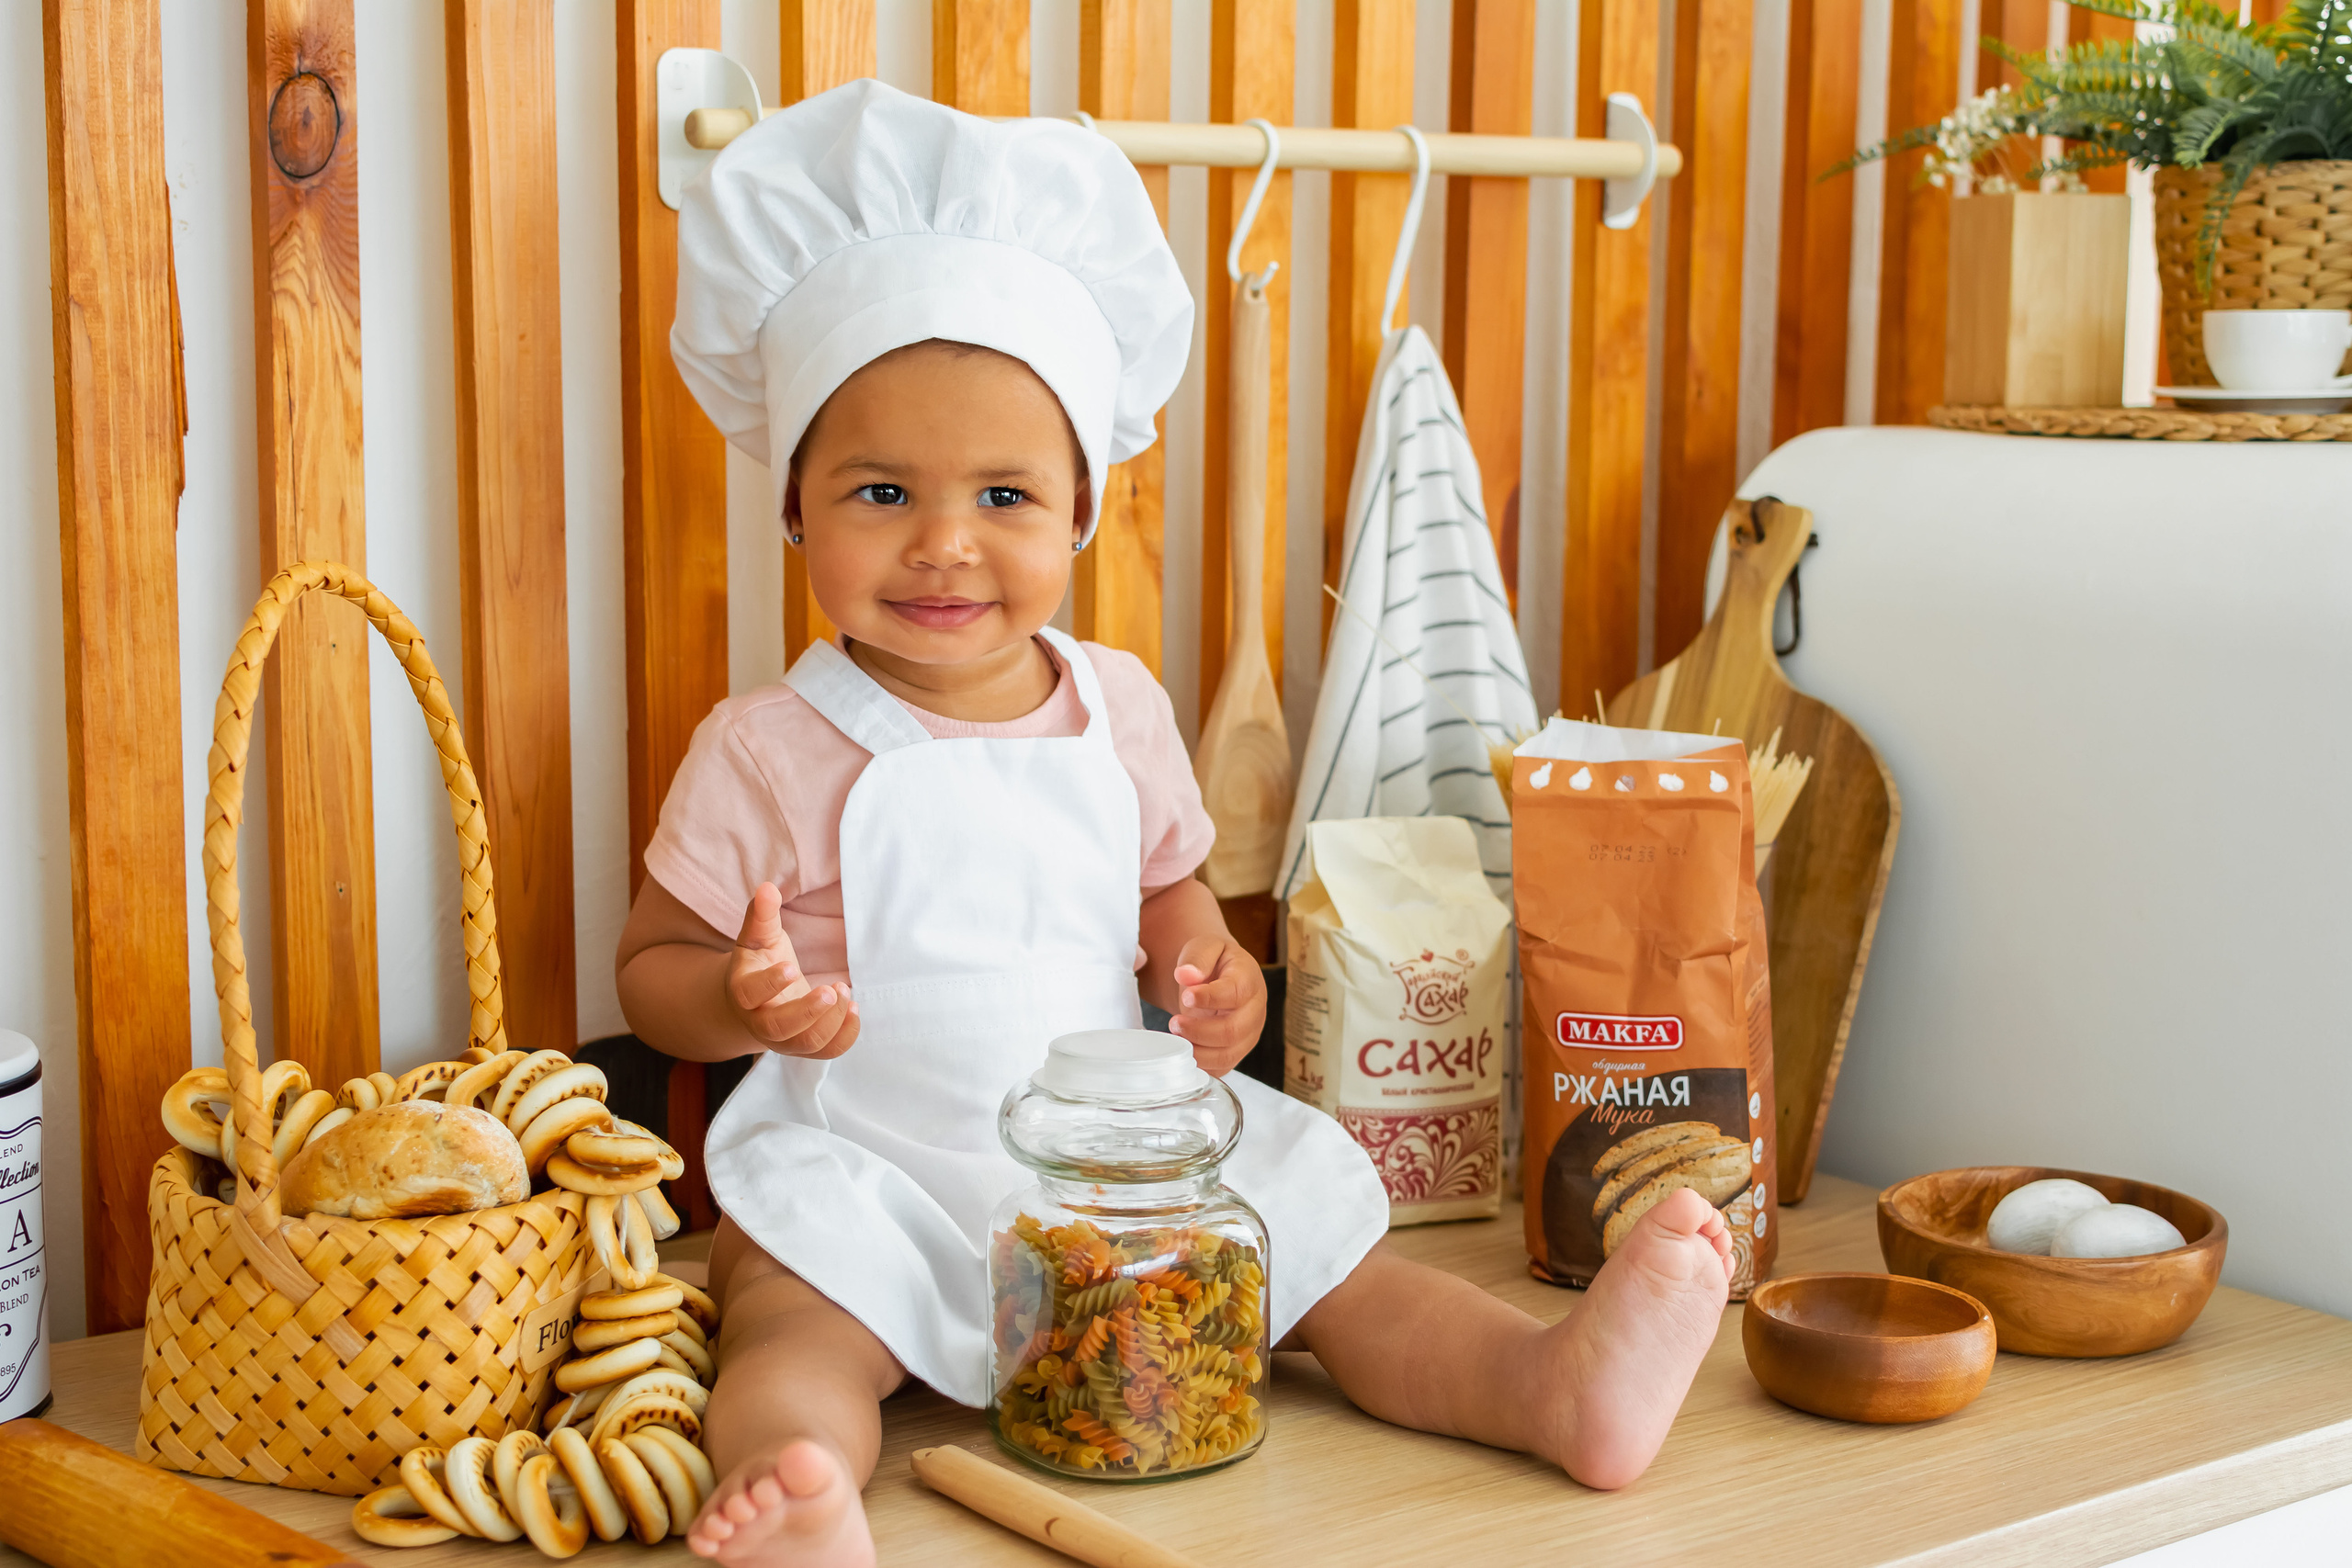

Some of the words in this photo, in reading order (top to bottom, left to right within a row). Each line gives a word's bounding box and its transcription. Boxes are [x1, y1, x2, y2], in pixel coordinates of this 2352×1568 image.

[1568, 1021, 1670, 1043] MAKFA
[1592, 1058, 1646, 1075] обдирная
[1554, 1072, 1690, 1107] РЖАНАЯ
[1590, 1102, 1655, 1135] Мука
[0, 1144, 23, 1159] END
[7, 1209, 32, 1253] A
[0, 1275, 19, 1292] ON
[22, 1264, 40, 1281] TEA
[0, 1293, 28, 1314] BLEND
